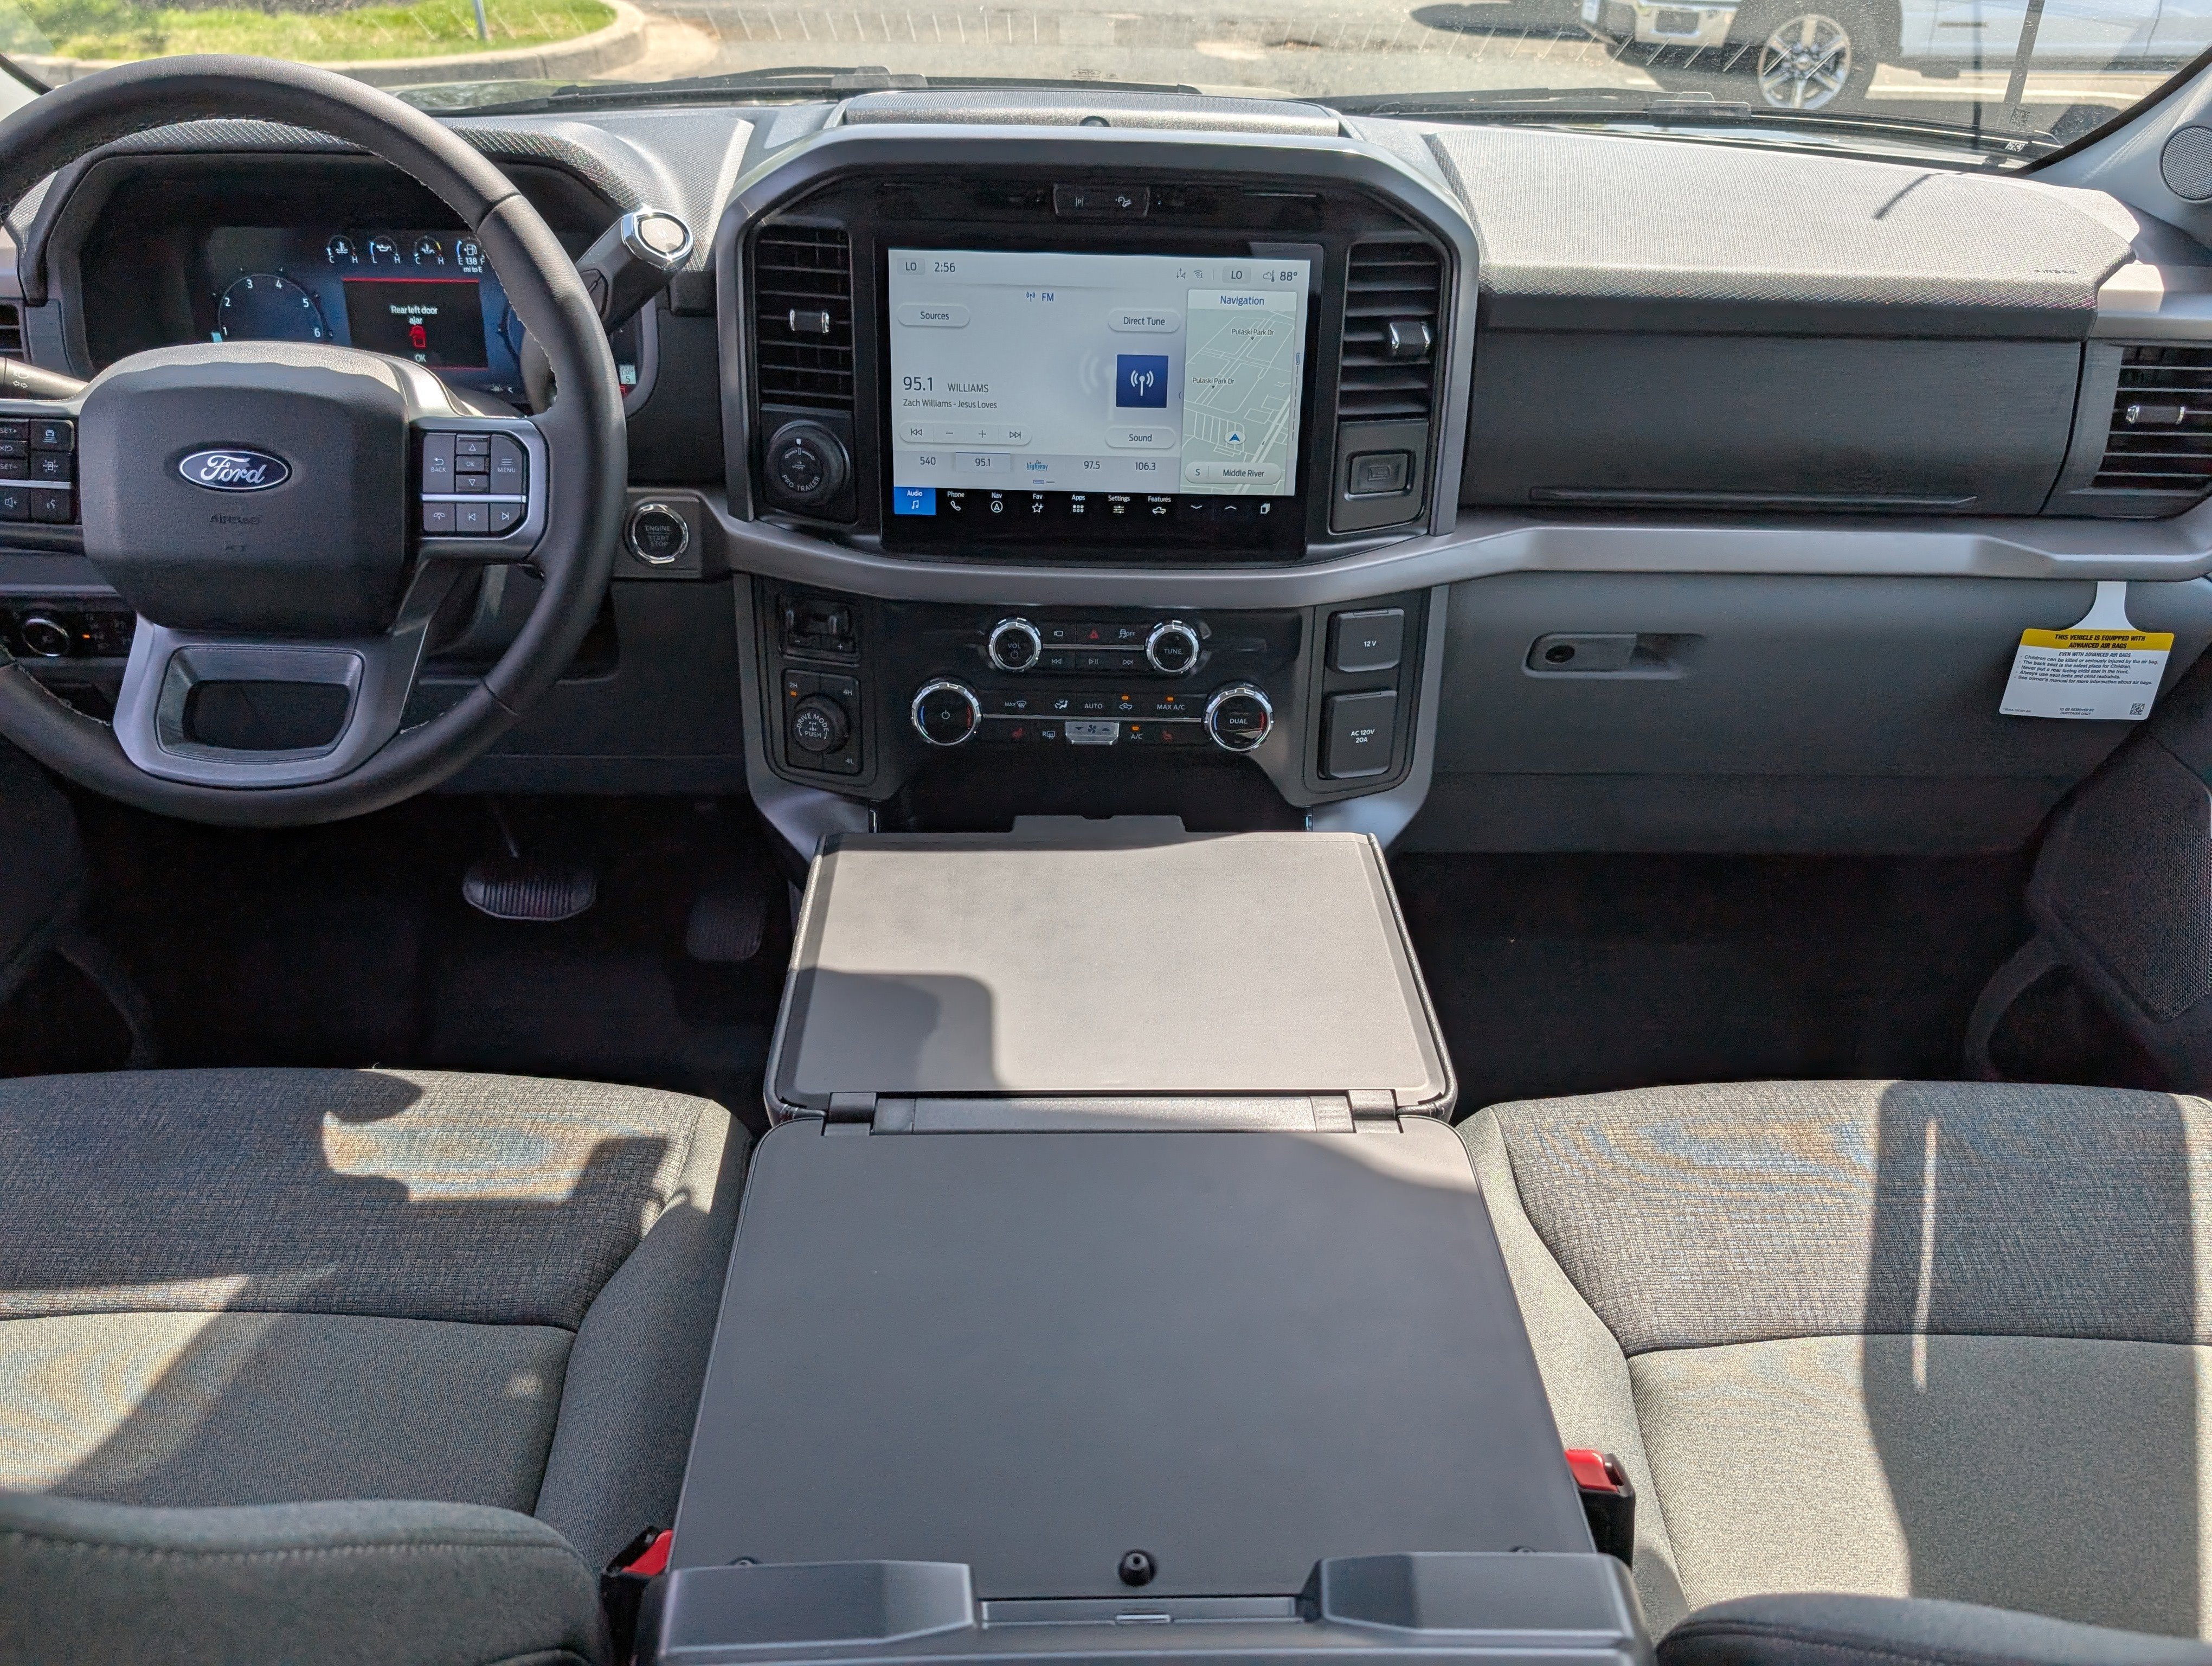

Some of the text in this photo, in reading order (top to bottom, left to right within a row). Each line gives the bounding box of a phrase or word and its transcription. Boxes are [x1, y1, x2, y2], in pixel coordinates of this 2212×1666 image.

[394, 256, 400, 264] H
[458, 257, 463, 265] E
[465, 257, 477, 265] 138
[905, 262, 917, 271] LO
[934, 262, 956, 272] 2:56
[1231, 271, 1243, 279] LO
[1280, 271, 1298, 281] 88°
[247, 279, 254, 289] 3
[275, 280, 282, 289] 4
[224, 297, 231, 307] 2
[1041, 293, 1054, 302] FM
[1220, 296, 1264, 306] Navigation
[303, 298, 309, 308] 5
[391, 305, 438, 315] Rear left door
[409, 316, 423, 325] ajar
[920, 311, 949, 321] Sources
[1123, 317, 1165, 326] Direct Tune
[223, 326, 228, 336] 1
[314, 328, 320, 337] 6
[415, 354, 426, 362] OK
[903, 376, 933, 392] 95.1
[948, 383, 989, 393] WILLIAMS
[903, 399, 997, 409] Zach Williams Jesus Loves
[920, 457, 936, 465] 540
[975, 458, 991, 467] 95.1
[1084, 461, 1101, 470] 97.5
[200, 454, 267, 483] Ford
[1026, 462, 1048, 471] highway
[1135, 462, 1156, 471] 106.3
[1223, 469, 1265, 478] Middle River
[782, 474, 820, 492] PRO TRAILER
[796, 713, 829, 732] DRIVE MODE
